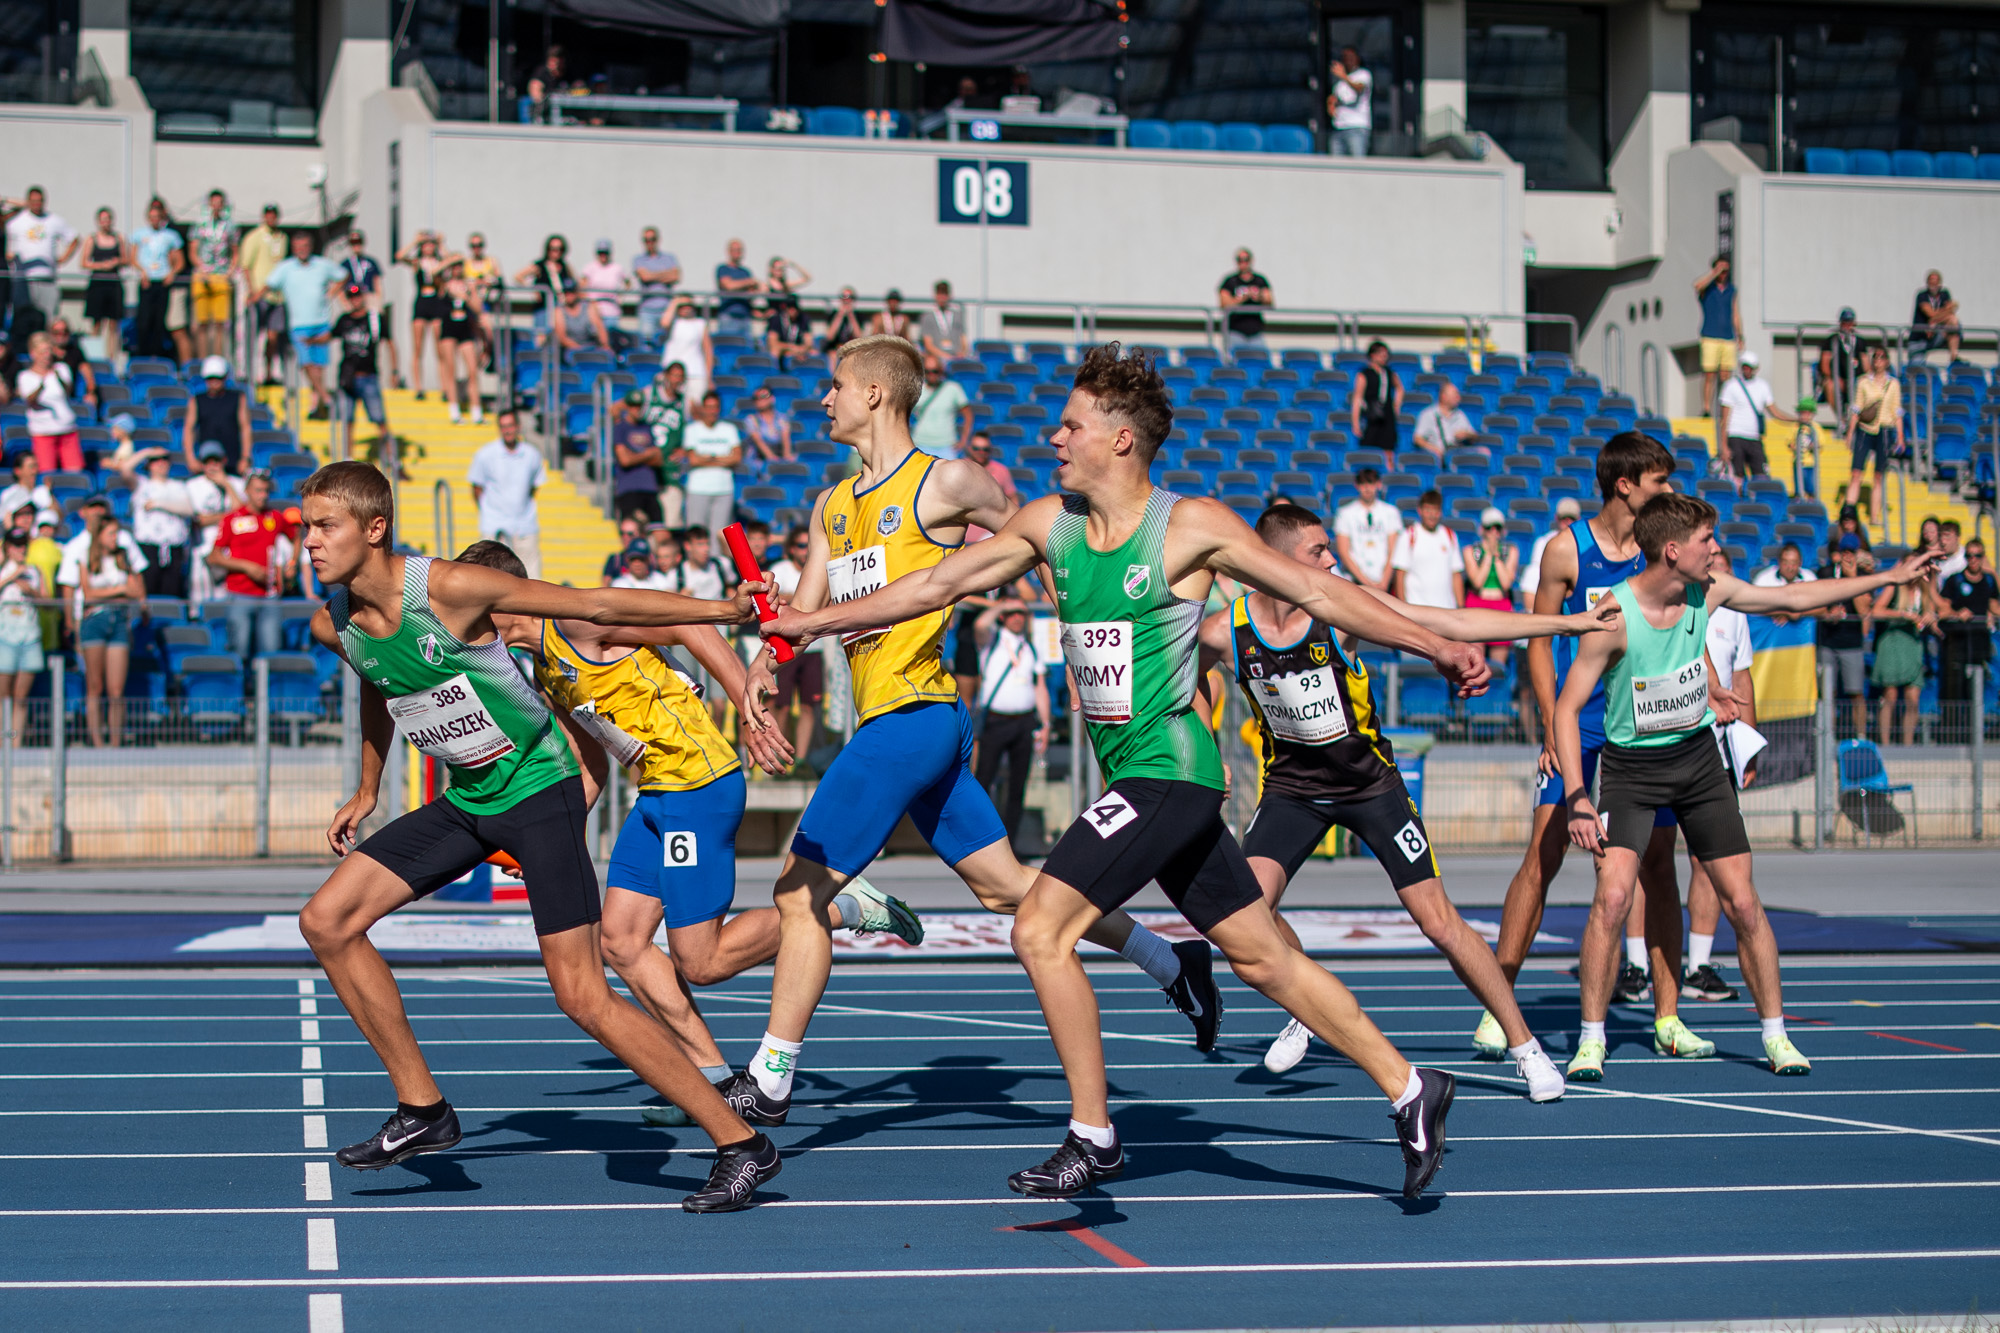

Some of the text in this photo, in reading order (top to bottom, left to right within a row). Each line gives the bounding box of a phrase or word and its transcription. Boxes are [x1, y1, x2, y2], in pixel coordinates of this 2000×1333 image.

[953, 165, 1013, 217] 08
[852, 552, 876, 575] 716
[1083, 628, 1121, 649] 393
[1300, 673, 1322, 692] 93
[1679, 663, 1701, 684] 619
[431, 685, 467, 708] 388
[1263, 695, 1339, 721] TOMALCZYK
[408, 710, 493, 749] BANASZEK
[1092, 803, 1127, 827] 4
[670, 834, 690, 864] 6
[1402, 828, 1422, 853] 8
